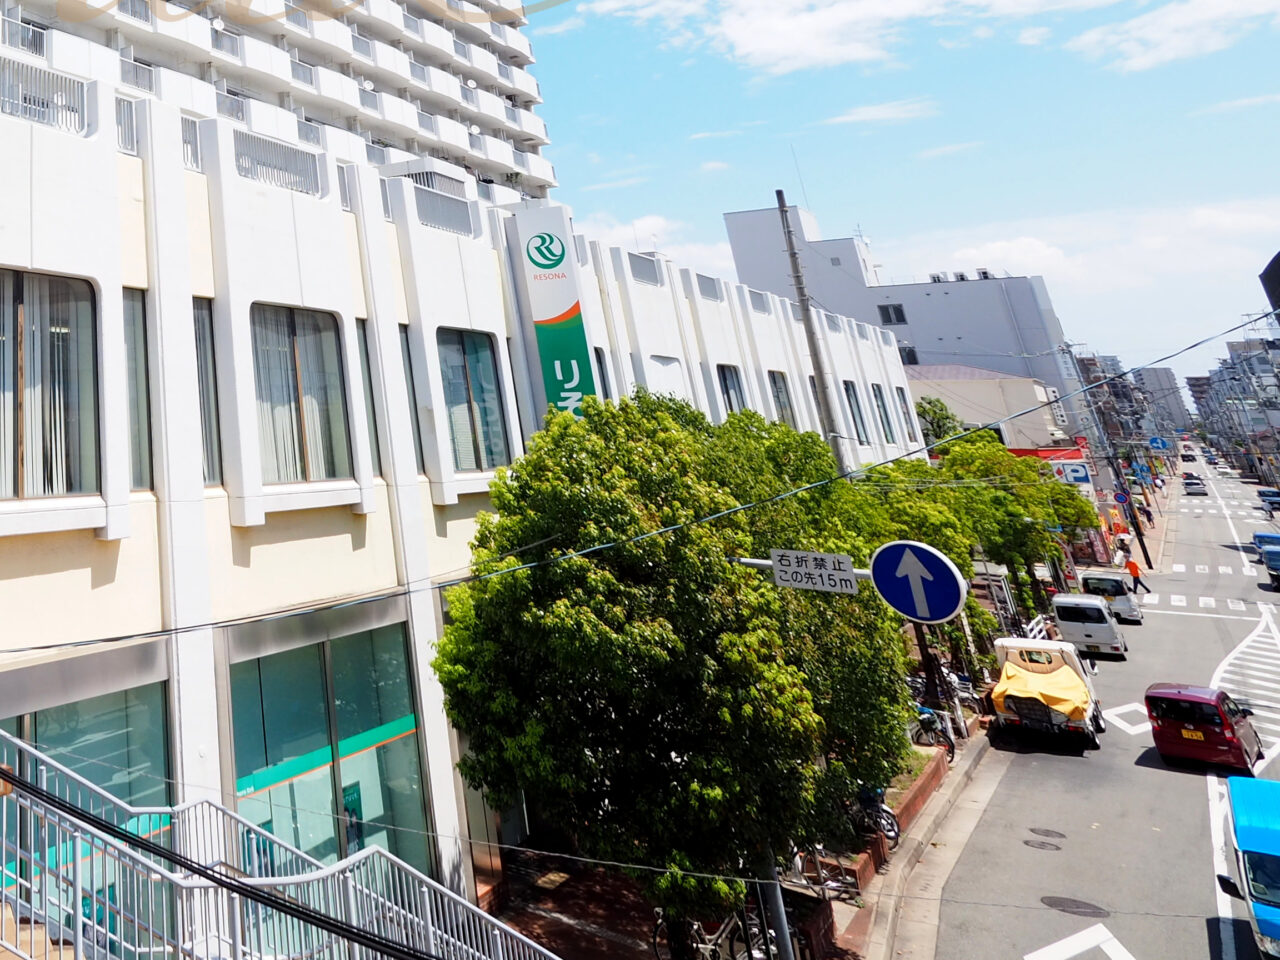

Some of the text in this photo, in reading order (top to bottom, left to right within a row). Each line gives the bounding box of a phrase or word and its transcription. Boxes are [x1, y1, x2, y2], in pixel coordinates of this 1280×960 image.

[533, 272, 567, 281] RESONA
[777, 553, 847, 572] 右折禁止
